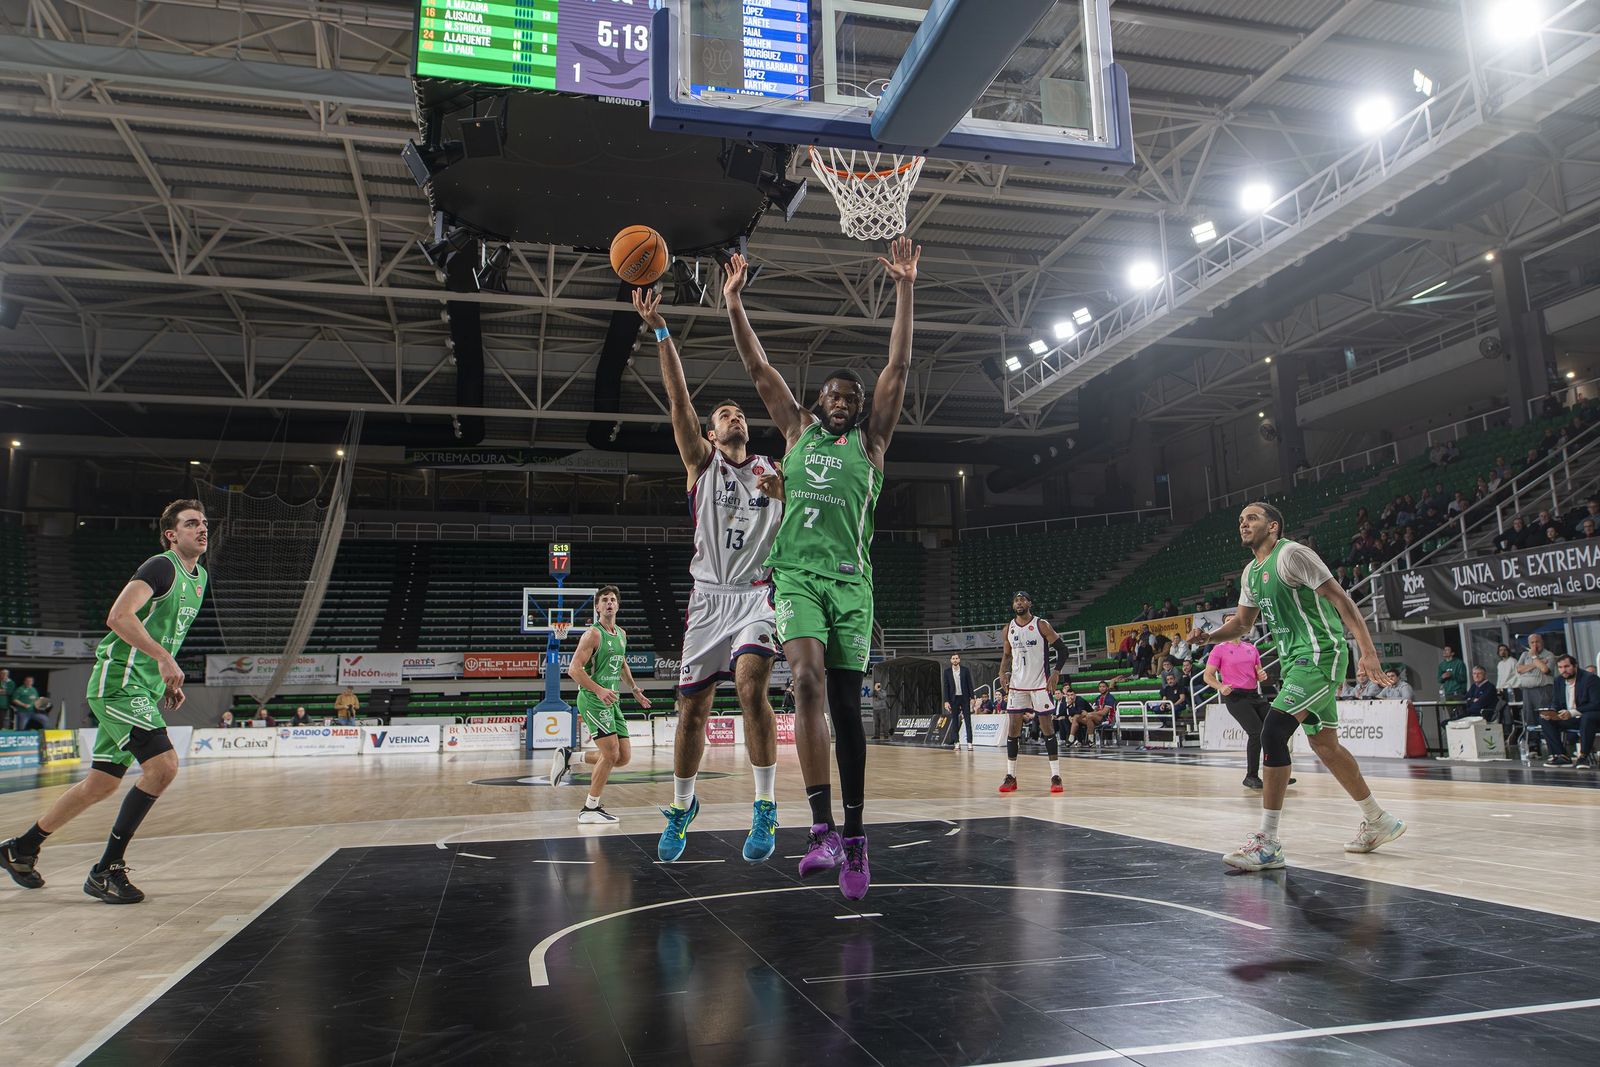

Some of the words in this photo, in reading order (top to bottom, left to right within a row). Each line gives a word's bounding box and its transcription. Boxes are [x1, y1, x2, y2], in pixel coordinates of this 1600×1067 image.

[425, 8, 436, 17] 16
[444, 9, 483, 24] A.USAOLA
[743, 5, 764, 17] LÓPEZ
[796, 13, 801, 22] 2
[444, 20, 492, 35] M.STRIKKER
[423, 29, 435, 40] 24
[443, 31, 491, 47] A.LAFUENTE
[597, 21, 649, 52] 5:13
[443, 42, 453, 53] LA
[455, 44, 475, 57] PAUL
[743, 47, 782, 61] RODRÍGUEZ
[795, 55, 804, 64] 10
[572, 62, 581, 83] 1
[765, 61, 799, 74] BARBARA
[743, 68, 766, 81] LÓPEZ
[795, 76, 805, 85] 14
[605, 96, 643, 109] MONDO
[413, 451, 507, 465] EXTREMADURA
[714, 489, 741, 506] Jaén
[803, 506, 820, 529] 7
[725, 528, 745, 551] 13
[553, 544, 569, 552] 5:13
[552, 556, 569, 571] 17
[1451, 562, 1495, 591] JUNTA
[1500, 557, 1521, 580] DE
[1462, 584, 1516, 607] Dirección
[1517, 576, 1563, 599] General
[1566, 575, 1582, 593] de
[402, 658, 436, 666] CORTÉS
[478, 660, 538, 668] NEPTUNO
[654, 657, 682, 671] Telep
[343, 668, 381, 678] Halcón
[380, 671, 399, 679] viajes
[292, 729, 321, 737] RADIO
[330, 728, 359, 737] MARCA
[388, 735, 430, 745] VEHINCA
